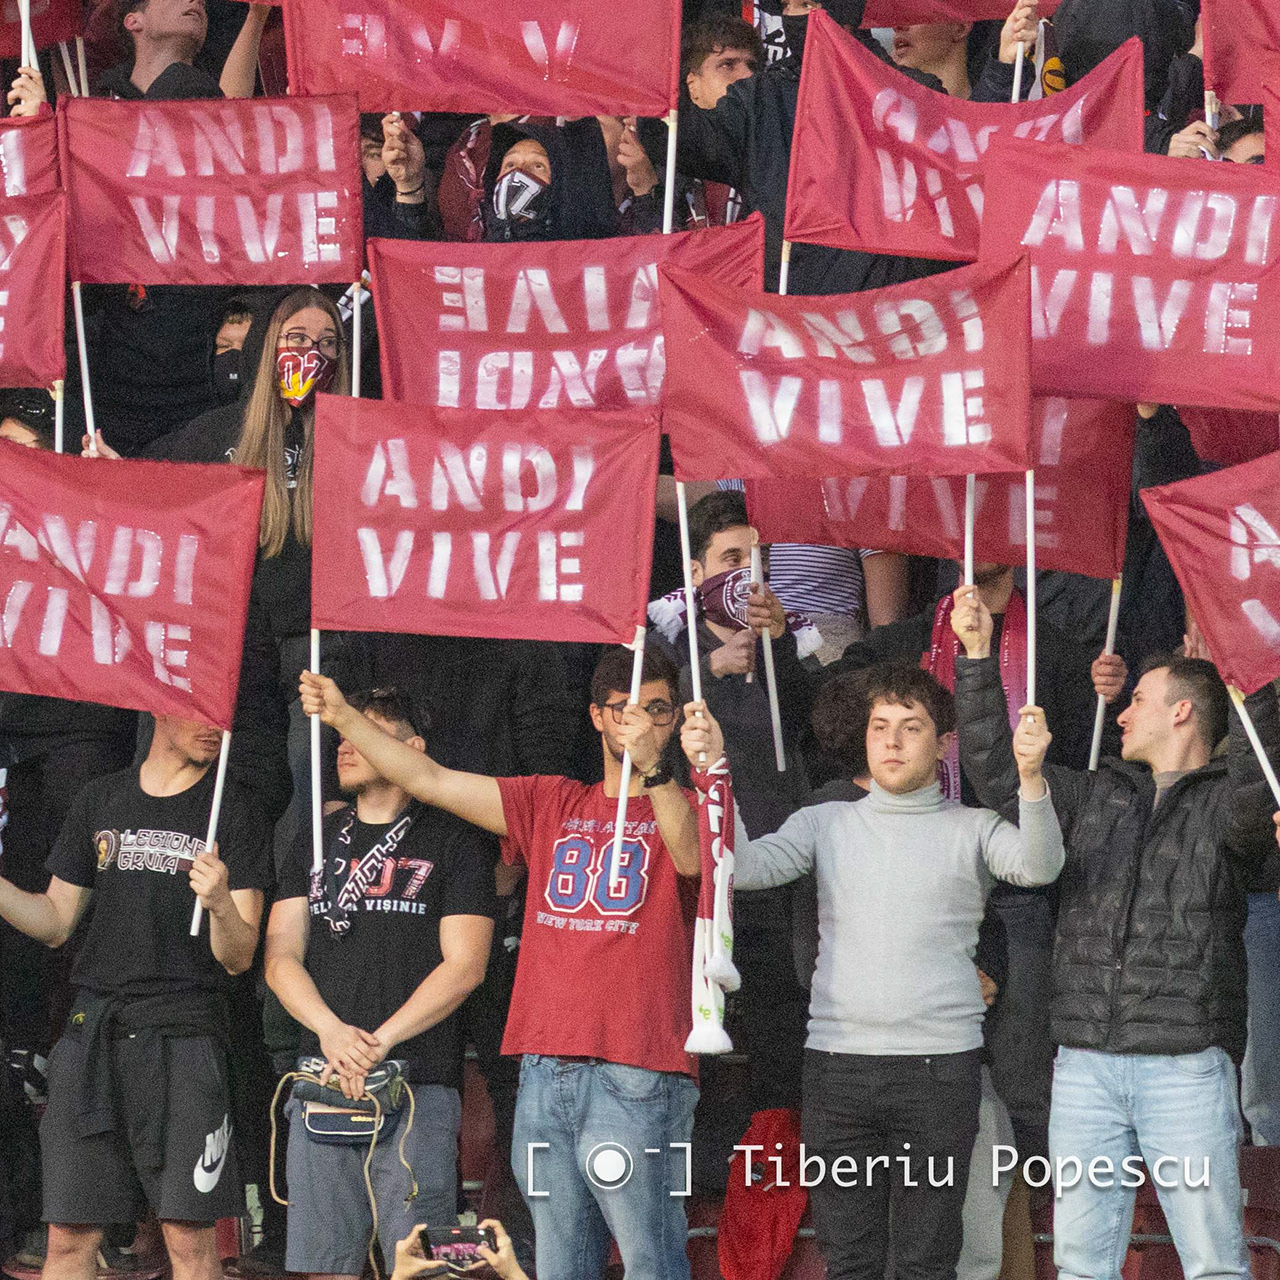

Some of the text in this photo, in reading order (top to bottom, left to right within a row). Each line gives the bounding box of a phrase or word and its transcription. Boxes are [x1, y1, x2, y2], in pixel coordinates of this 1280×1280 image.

[126, 104, 335, 177] ANDI
[129, 191, 341, 264] VIVE
[1020, 181, 1274, 264] ANDI
[741, 290, 983, 364] ANDI
[1030, 264, 1257, 354] VIVE
[742, 369, 991, 446] VIVE
[362, 439, 596, 512] ANDI
[357, 528, 585, 601] VIVE
[364, 899, 427, 916] VIȘINIE
[545, 834, 652, 915] 88
